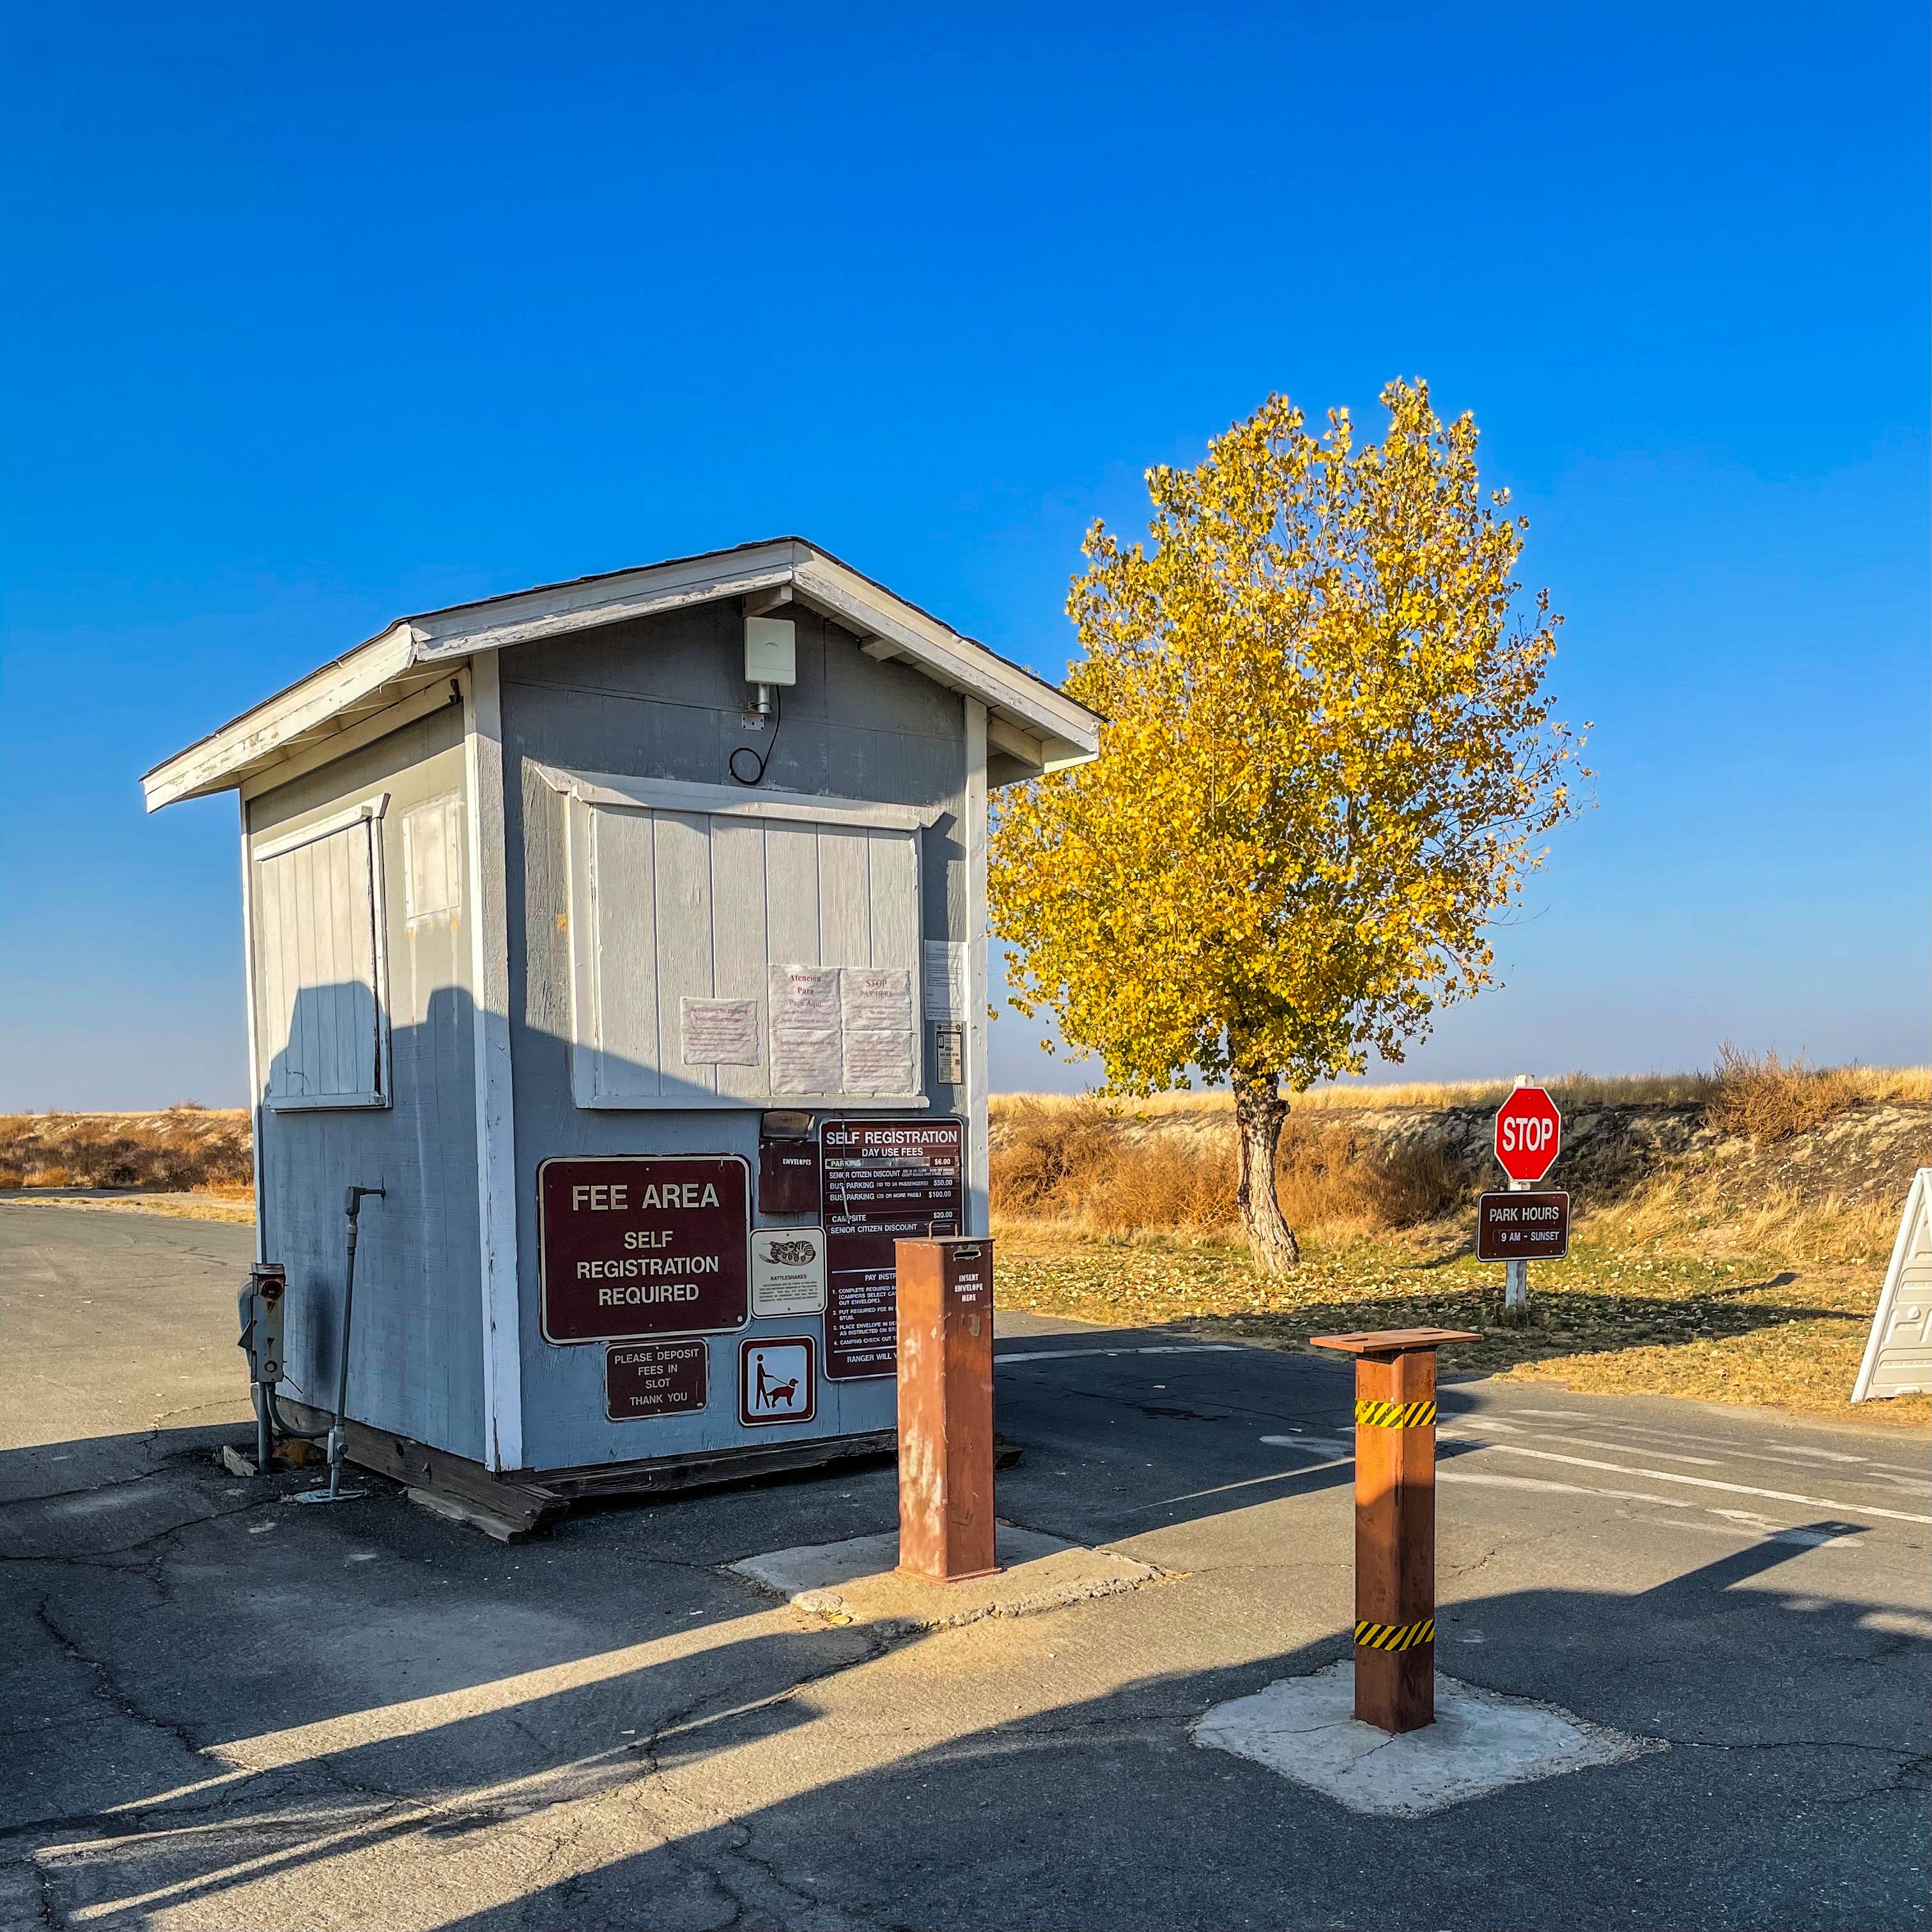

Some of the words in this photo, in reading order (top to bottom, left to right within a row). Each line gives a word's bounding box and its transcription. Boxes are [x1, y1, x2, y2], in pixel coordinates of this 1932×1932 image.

[866, 979, 887, 988] STOP
[789, 999, 805, 1008] Page
[826, 1131, 860, 1145] SELF
[865, 1131, 957, 1144] REGISTRATION
[1503, 1117, 1553, 1152] STOP
[862, 1148, 879, 1157] DAY
[881, 1148, 899, 1157] USE
[901, 1147, 923, 1156] FEES
[573, 1185, 628, 1210] FEE
[642, 1183, 720, 1209] AREA
[831, 1214, 867, 1223] CAMPSITE
[1489, 1208, 1518, 1222] PARK
[1522, 1207, 1559, 1221] HOURS
[885, 1223, 918, 1232] DISCOUNT
[624, 1230, 674, 1249] SELF
[1501, 1232, 1507, 1242] 9
[1509, 1232, 1520, 1241] AM
[1531, 1231, 1559, 1241] SUNSET
[576, 1256, 718, 1279] REGISTRATION
[959, 1273, 979, 1282] INSERT
[954, 1283, 983, 1292] ENVELOPE
[599, 1284, 699, 1306] REQUIRED
[962, 1294, 977, 1302] HERE
[615, 1352, 653, 1364] PLEASE
[657, 1349, 699, 1361] DEPOSIT
[847, 1354, 874, 1363] RANGER
[638, 1365, 663, 1376] FEES
[668, 1364, 677, 1373] IN
[645, 1378, 671, 1389] SLOT
[630, 1394, 663, 1406] THANK
[667, 1392, 688, 1402] YOU
